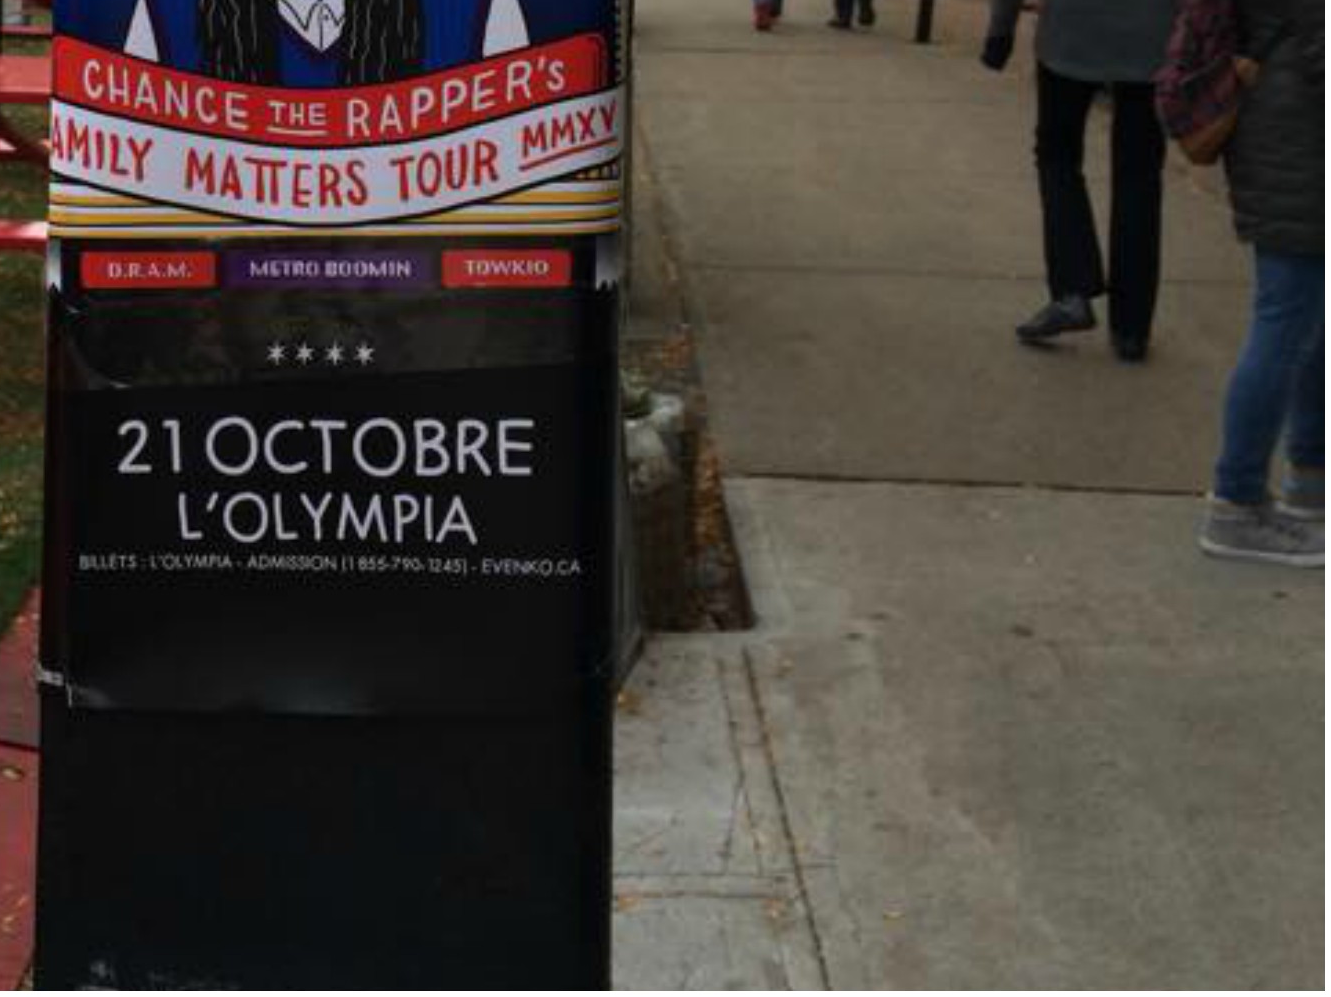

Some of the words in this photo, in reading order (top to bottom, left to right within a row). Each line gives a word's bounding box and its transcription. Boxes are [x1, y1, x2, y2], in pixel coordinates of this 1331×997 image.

[83, 59, 249, 131] CHANCE
[267, 101, 327, 126] THE
[346, 55, 566, 137] RAPPER'S
[51, 114, 153, 182] AMILY
[184, 148, 370, 207] MATTERS
[390, 139, 498, 201] TOUR
[522, 98, 617, 159] MMXV
[106, 261, 193, 280] D.R.A.M.
[249, 260, 319, 278] METRO
[325, 260, 412, 279] BOOMIN
[464, 259, 550, 277] TOWKIO
[117, 418, 183, 474] 21
[205, 415, 535, 478] OCTOBRE
[178, 491, 478, 544] L'OLYMPIA
[79, 555, 137, 571] BILLETS
[150, 555, 233, 571] L'OLYMPIA
[247, 555, 337, 571] ADMISSION
[481, 557, 581, 576] EVENKO.CA
